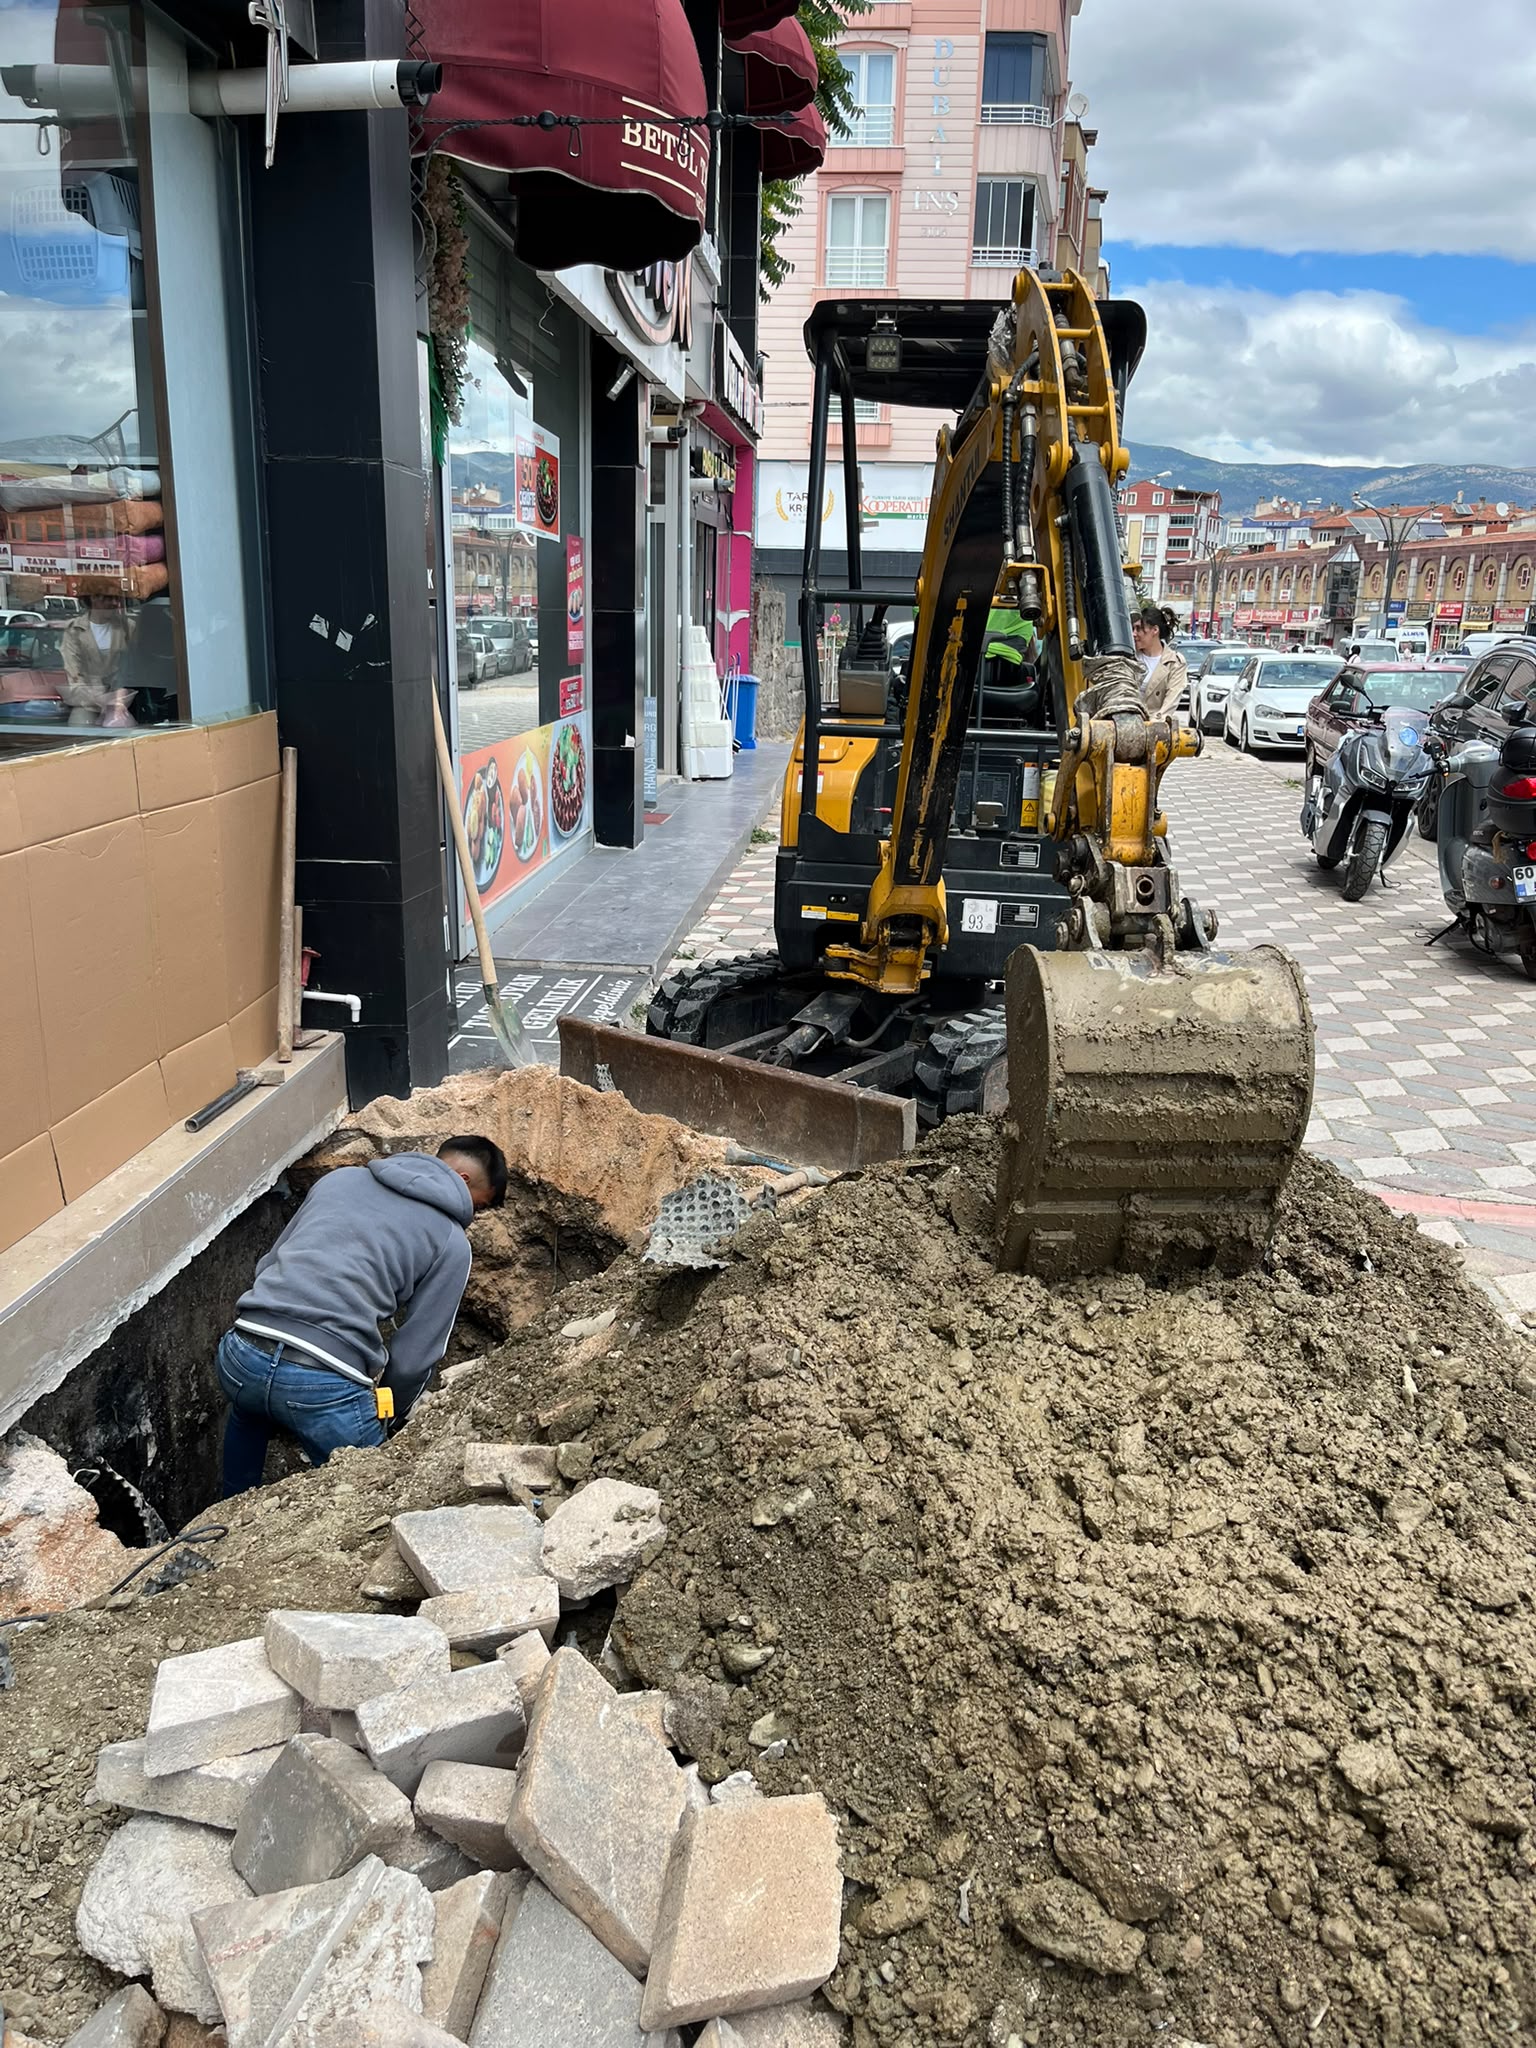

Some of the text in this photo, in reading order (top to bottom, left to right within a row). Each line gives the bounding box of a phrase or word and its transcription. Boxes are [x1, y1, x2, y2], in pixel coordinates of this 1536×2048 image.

[1514, 867, 1535, 881] 60
[968, 914, 984, 931] 93
[521, 977, 588, 1029] GELİNLİK
